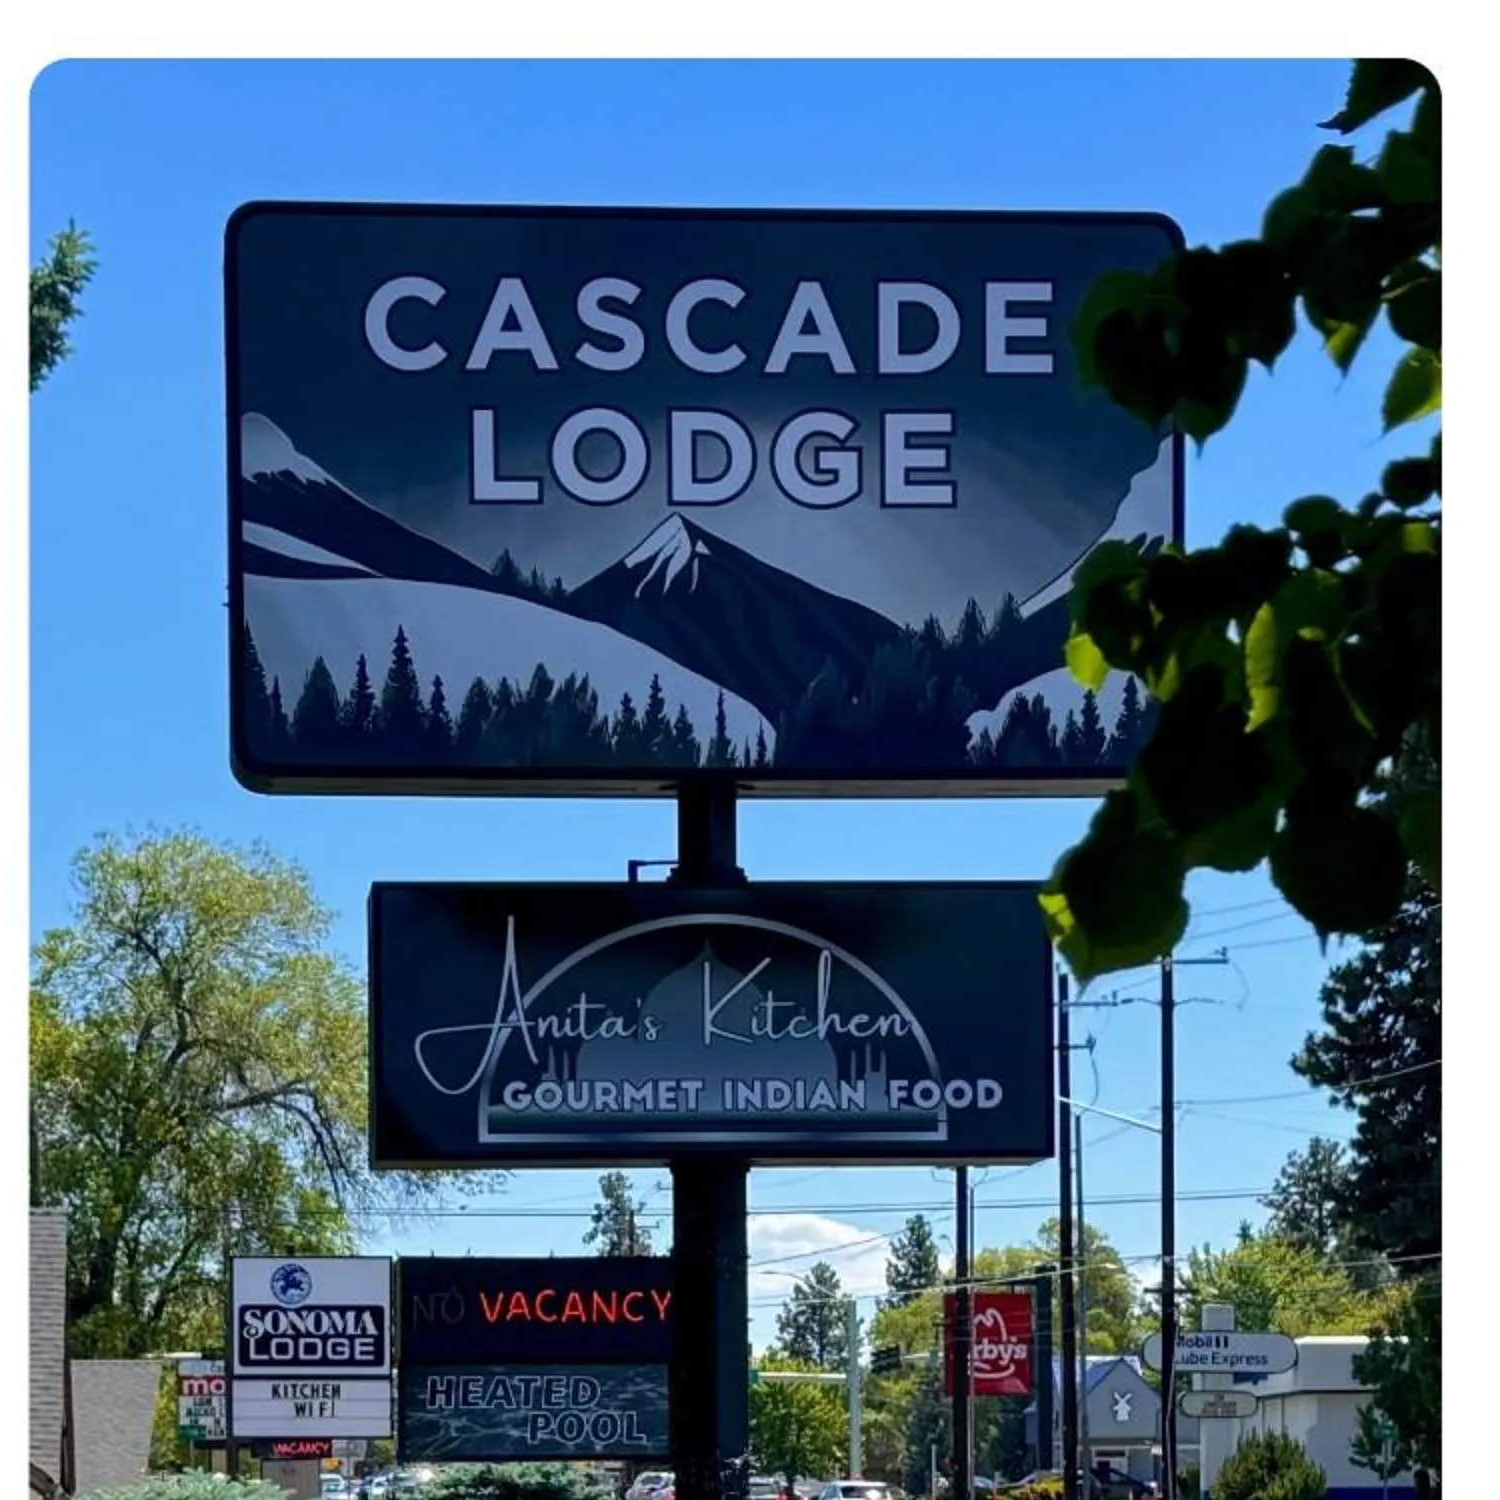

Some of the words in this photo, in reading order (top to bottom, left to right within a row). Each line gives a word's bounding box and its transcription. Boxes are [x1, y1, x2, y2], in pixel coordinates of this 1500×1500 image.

[363, 275, 1055, 375] CASCADE
[468, 407, 957, 508] LODGE
[414, 915, 661, 1094] Anita's
[703, 949, 912, 1045] Kitchen
[502, 1079, 705, 1112] GOURMET
[722, 1079, 868, 1112] INDIAN
[888, 1079, 1004, 1110] FOOD
[479, 1289, 672, 1323] VACANCY
[243, 1309, 379, 1339] SONOMA
[249, 1337, 376, 1361] LODGE
[971, 1337, 1028, 1366] rby's
[1211, 1351, 1269, 1367] Express
[271, 1383, 341, 1400] KITCHEN
[426, 1375, 601, 1409] HEATED
[527, 1411, 648, 1445] POOL
[271, 1440, 331, 1457] VACANCY
